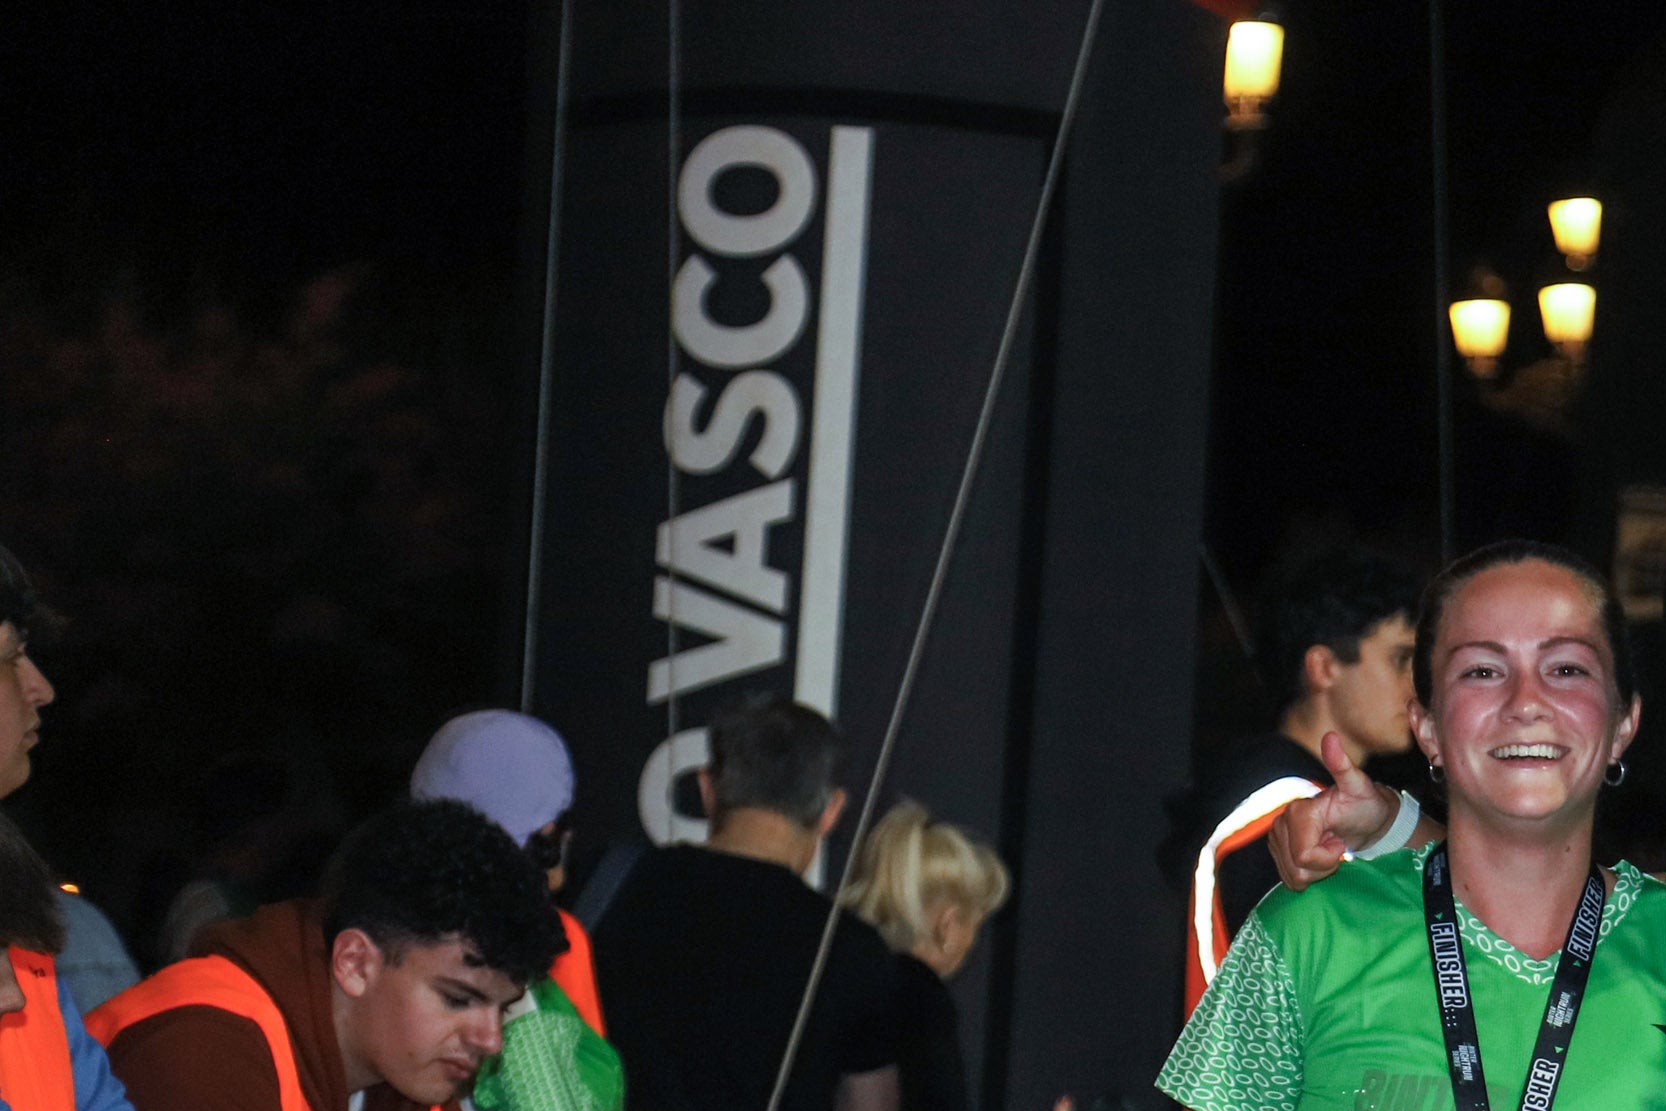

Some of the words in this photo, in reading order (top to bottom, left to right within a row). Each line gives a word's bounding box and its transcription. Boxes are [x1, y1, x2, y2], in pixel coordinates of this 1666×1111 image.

[646, 124, 820, 705] VASCO
[1567, 877, 1602, 961] FINISHER
[1431, 922, 1467, 1008] FINISHER
